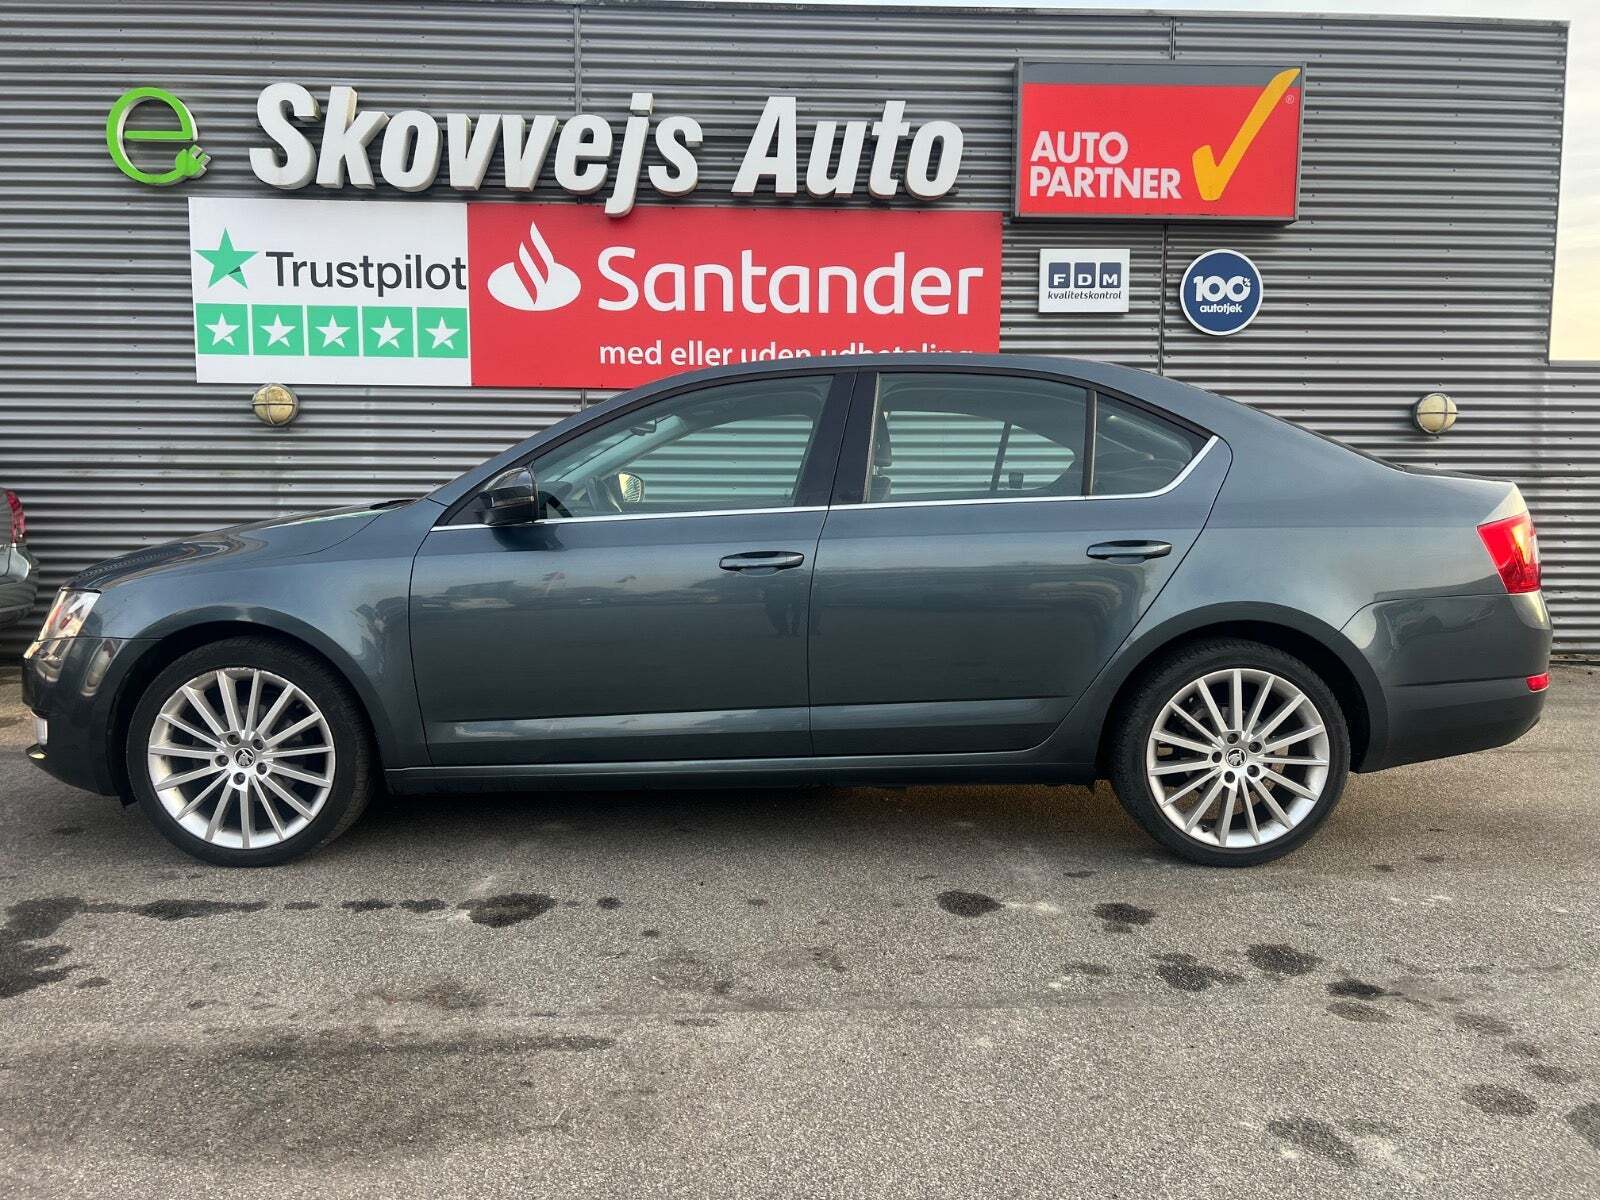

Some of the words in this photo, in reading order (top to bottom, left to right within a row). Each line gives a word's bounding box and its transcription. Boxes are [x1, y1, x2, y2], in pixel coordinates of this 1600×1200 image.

[249, 82, 704, 218] Skovvejs
[731, 96, 964, 200] Auto
[1030, 131, 1129, 164] AUTO
[1029, 165, 1182, 199] PARTNER
[265, 250, 467, 298] Trustpilot
[597, 246, 984, 316] Santander
[1053, 273, 1118, 286] FDM
[1047, 290, 1122, 300] kvalitetskontrol
[1199, 302, 1243, 315] autotjek
[600, 339, 662, 365] med
[670, 339, 733, 367] eller
